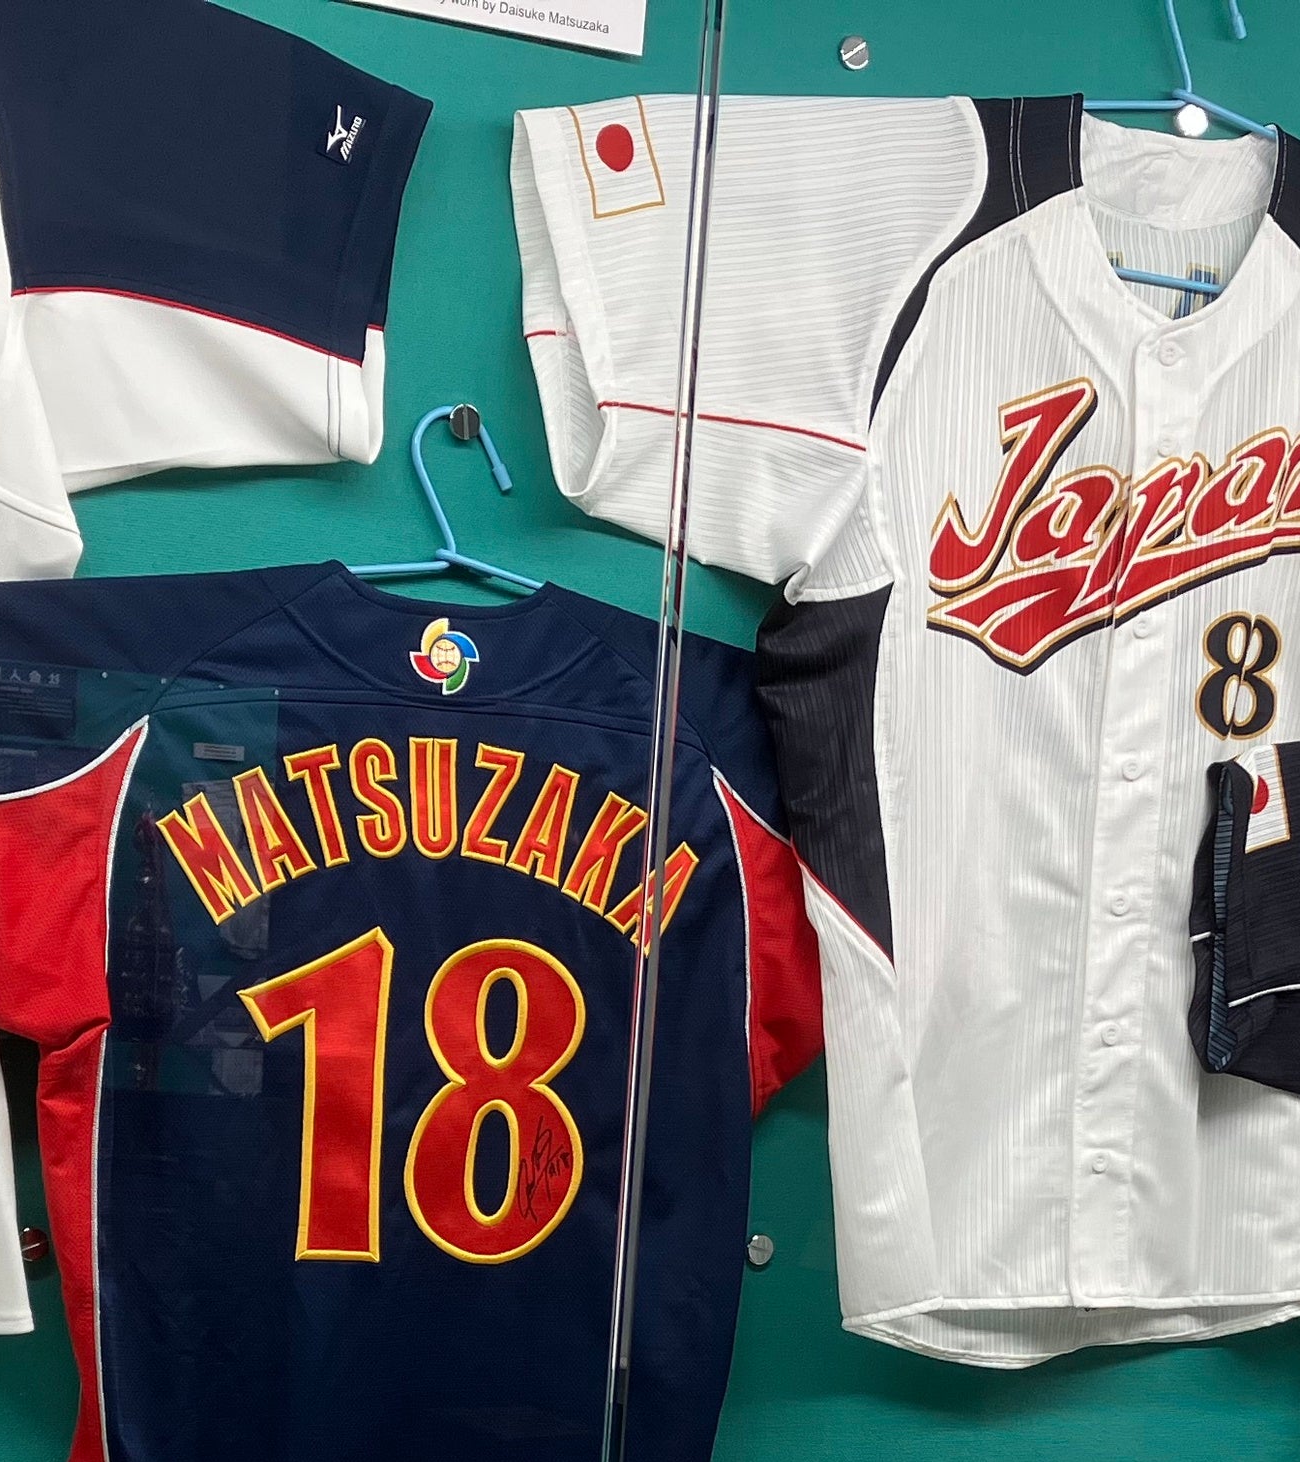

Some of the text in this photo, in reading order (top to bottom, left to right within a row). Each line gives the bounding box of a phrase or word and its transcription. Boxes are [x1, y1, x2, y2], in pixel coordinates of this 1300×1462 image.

[499, 3, 546, 21] Daisuke
[549, 11, 610, 34] Matsuzaka
[340, 115, 363, 161] MIZUNO
[1194, 610, 1283, 741] 8
[156, 737, 700, 956] MATSUZAKA
[237, 926, 586, 1265] 18
